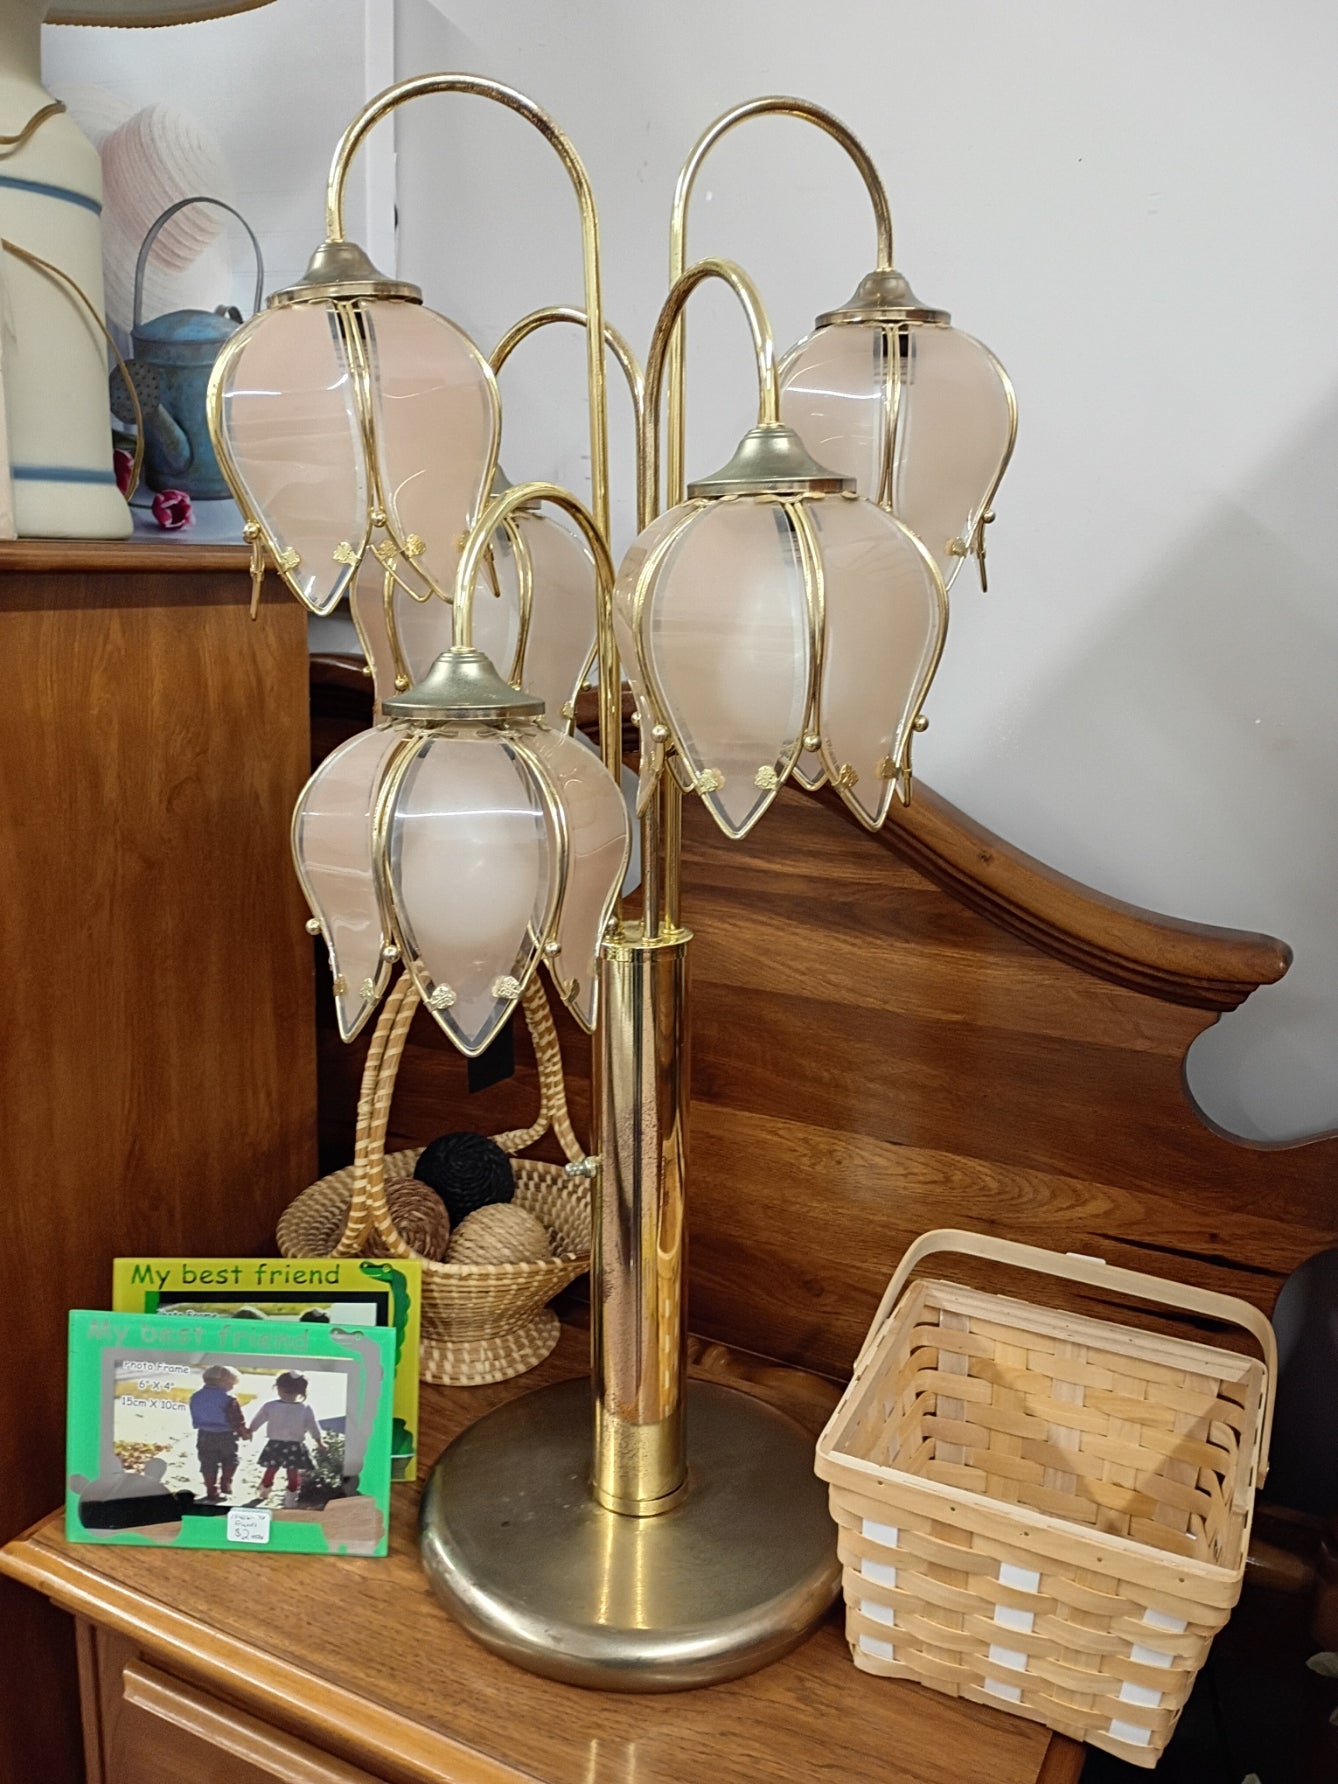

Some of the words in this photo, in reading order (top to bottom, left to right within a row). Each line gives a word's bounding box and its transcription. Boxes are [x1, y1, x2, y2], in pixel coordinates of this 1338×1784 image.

[131, 1263, 170, 1290] My
[182, 1263, 243, 1285] best
[256, 1263, 340, 1285] friend
[86, 1319, 130, 1345] My
[140, 1321, 205, 1344] best
[217, 1324, 309, 1352] friend
[156, 1363, 190, 1374] Frame
[121, 1396, 147, 1407] 15cm
[161, 1400, 187, 1411] 10cm
